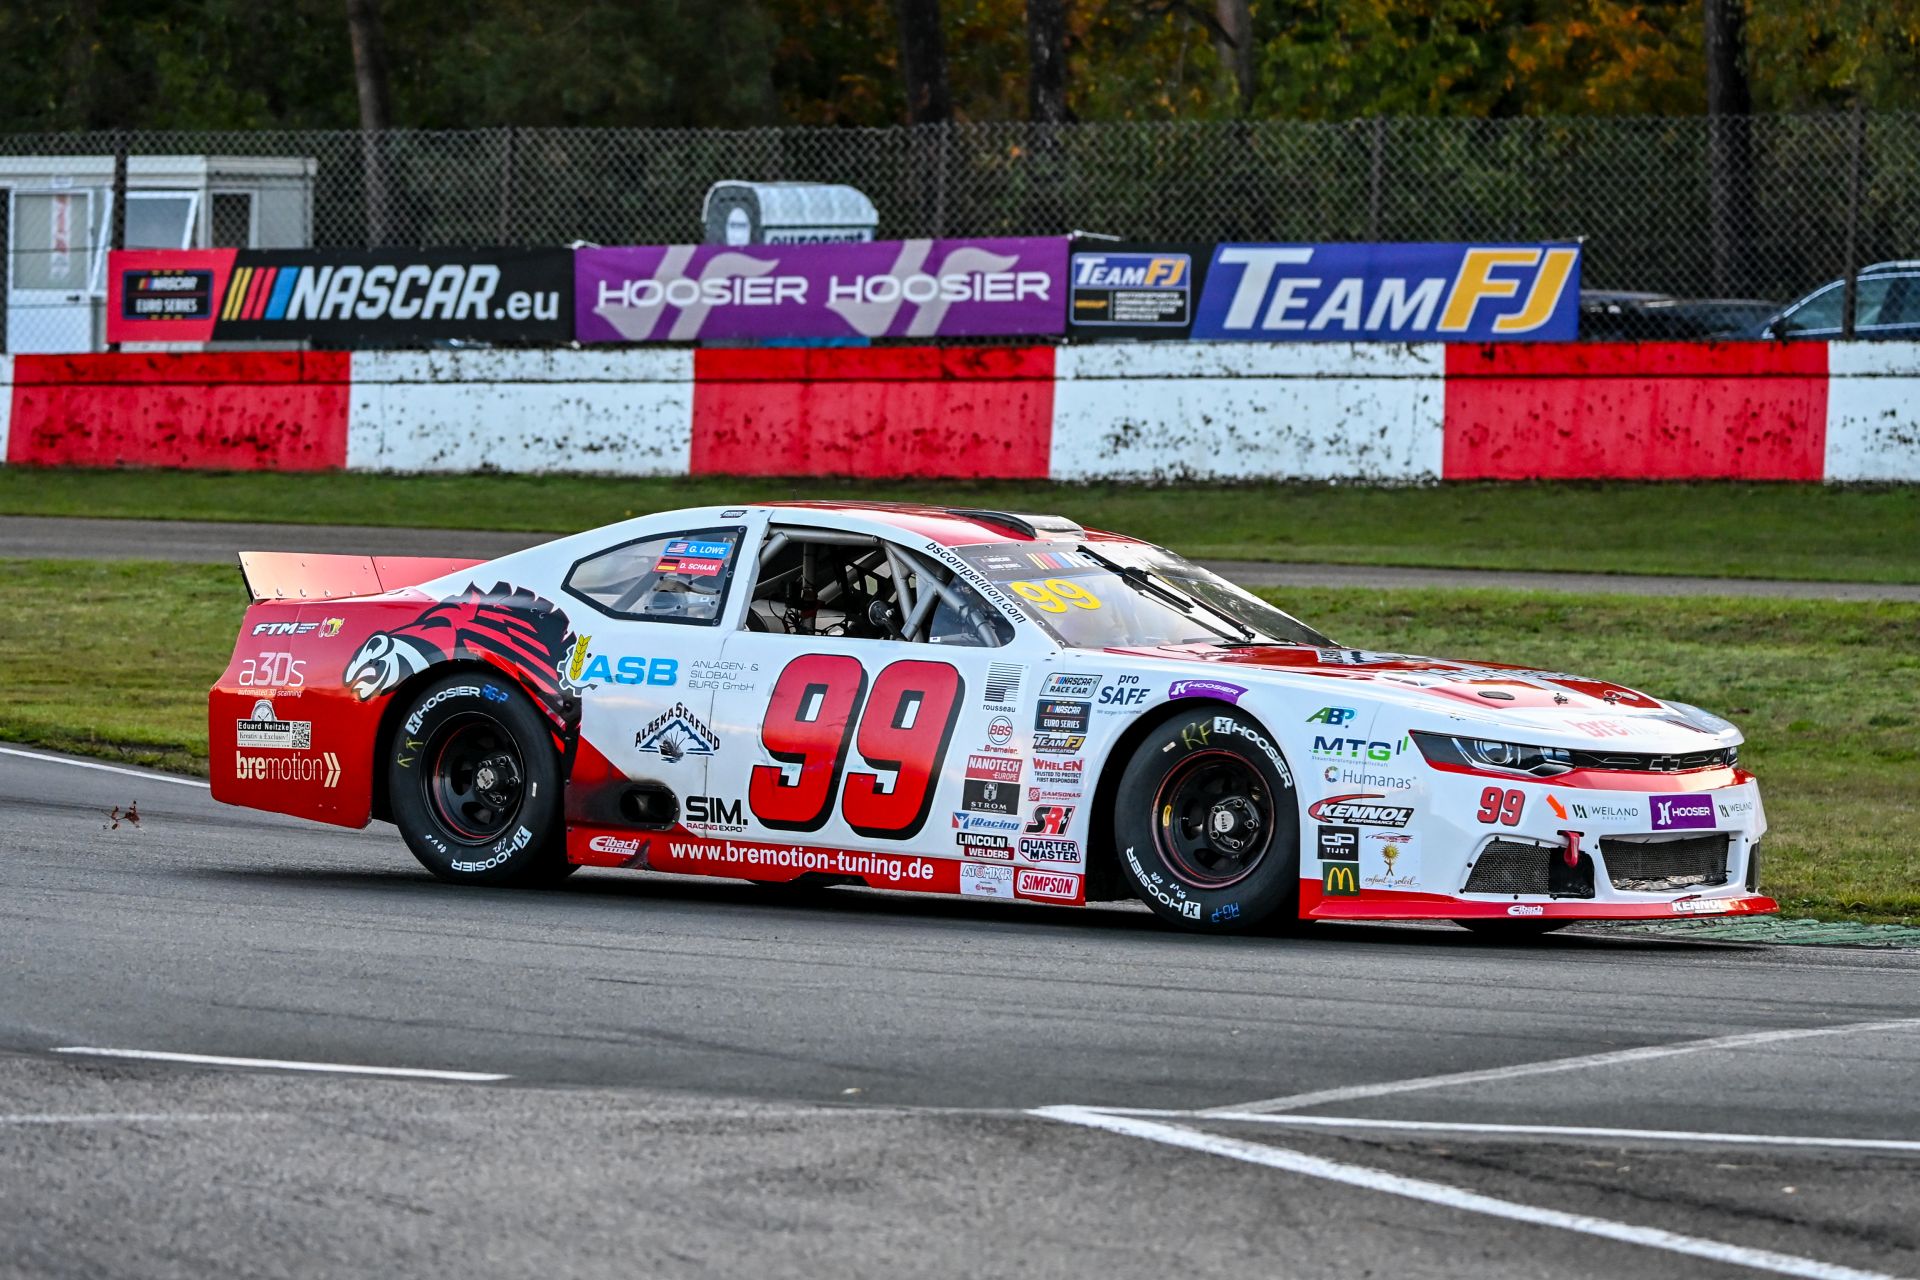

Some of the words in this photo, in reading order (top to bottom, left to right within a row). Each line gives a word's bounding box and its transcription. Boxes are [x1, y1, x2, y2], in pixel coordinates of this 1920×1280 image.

[598, 277, 808, 308] HOOSIER
[828, 271, 1050, 304] HOOSIER
[136, 298, 163, 313] EURO
[164, 298, 198, 313] SERIES
[700, 546, 726, 555] LOWE
[688, 563, 717, 571] SCHAAK
[925, 542, 1027, 624] bscompetition.com
[1008, 578, 1102, 613] 99
[251, 622, 300, 636] FTM
[580, 654, 679, 687] ASB
[692, 660, 747, 671] ANLAGEN-
[750, 663, 759, 672] &
[690, 670, 737, 681] SILOBAU
[1062, 676, 1093, 687] NASCAR
[1117, 674, 1140, 686] pro
[237, 688, 268, 696] automated
[268, 688, 277, 696] 3D
[277, 690, 302, 698] scanning
[688, 680, 720, 689] BURG
[722, 681, 755, 691] GmbH
[1189, 682, 1239, 695] HOOSIER
[418, 685, 480, 718] HOOSIER
[1098, 685, 1151, 705] SAFE
[982, 704, 1016, 713] rousseau
[1055, 705, 1082, 715] NASCAR
[238, 721, 262, 730] Eduard
[264, 722, 291, 731] Neitzke
[634, 707, 675, 748] ALASKA
[675, 701, 721, 751] SEAFOOD
[989, 724, 1012, 736] BBS
[1043, 718, 1060, 727] EURO
[1060, 719, 1080, 729] SERIES
[748, 652, 966, 841] 99
[1313, 735, 1391, 761] MTG
[1232, 722, 1293, 789] HOOSIER
[235, 751, 323, 781] bremotion
[968, 756, 1020, 772] NANOTECH
[1032, 757, 1083, 772] WHELEN
[1342, 769, 1411, 790] Humanas
[1316, 803, 1409, 821] KENNOL
[1476, 786, 1527, 827] 99
[1591, 806, 1639, 817] WEILAND
[1671, 806, 1711, 817] HOOSIER
[686, 822, 718, 831] RACING
[719, 825, 743, 833] EXPO
[971, 817, 1020, 831] iRacing
[1347, 818, 1394, 826] PERFORMANCE
[589, 835, 640, 852] Eibach
[958, 833, 1006, 848] LINCOLN
[1020, 840, 1075, 853] QUARTER
[451, 842, 519, 872] HOOSIER
[968, 847, 1009, 859] WELDERS
[1030, 850, 1078, 861] MASTER
[669, 841, 934, 881] www.bremotion-tuning.de
[1021, 874, 1074, 894] SIMPSON
[1126, 846, 1184, 912] HOOSIER
